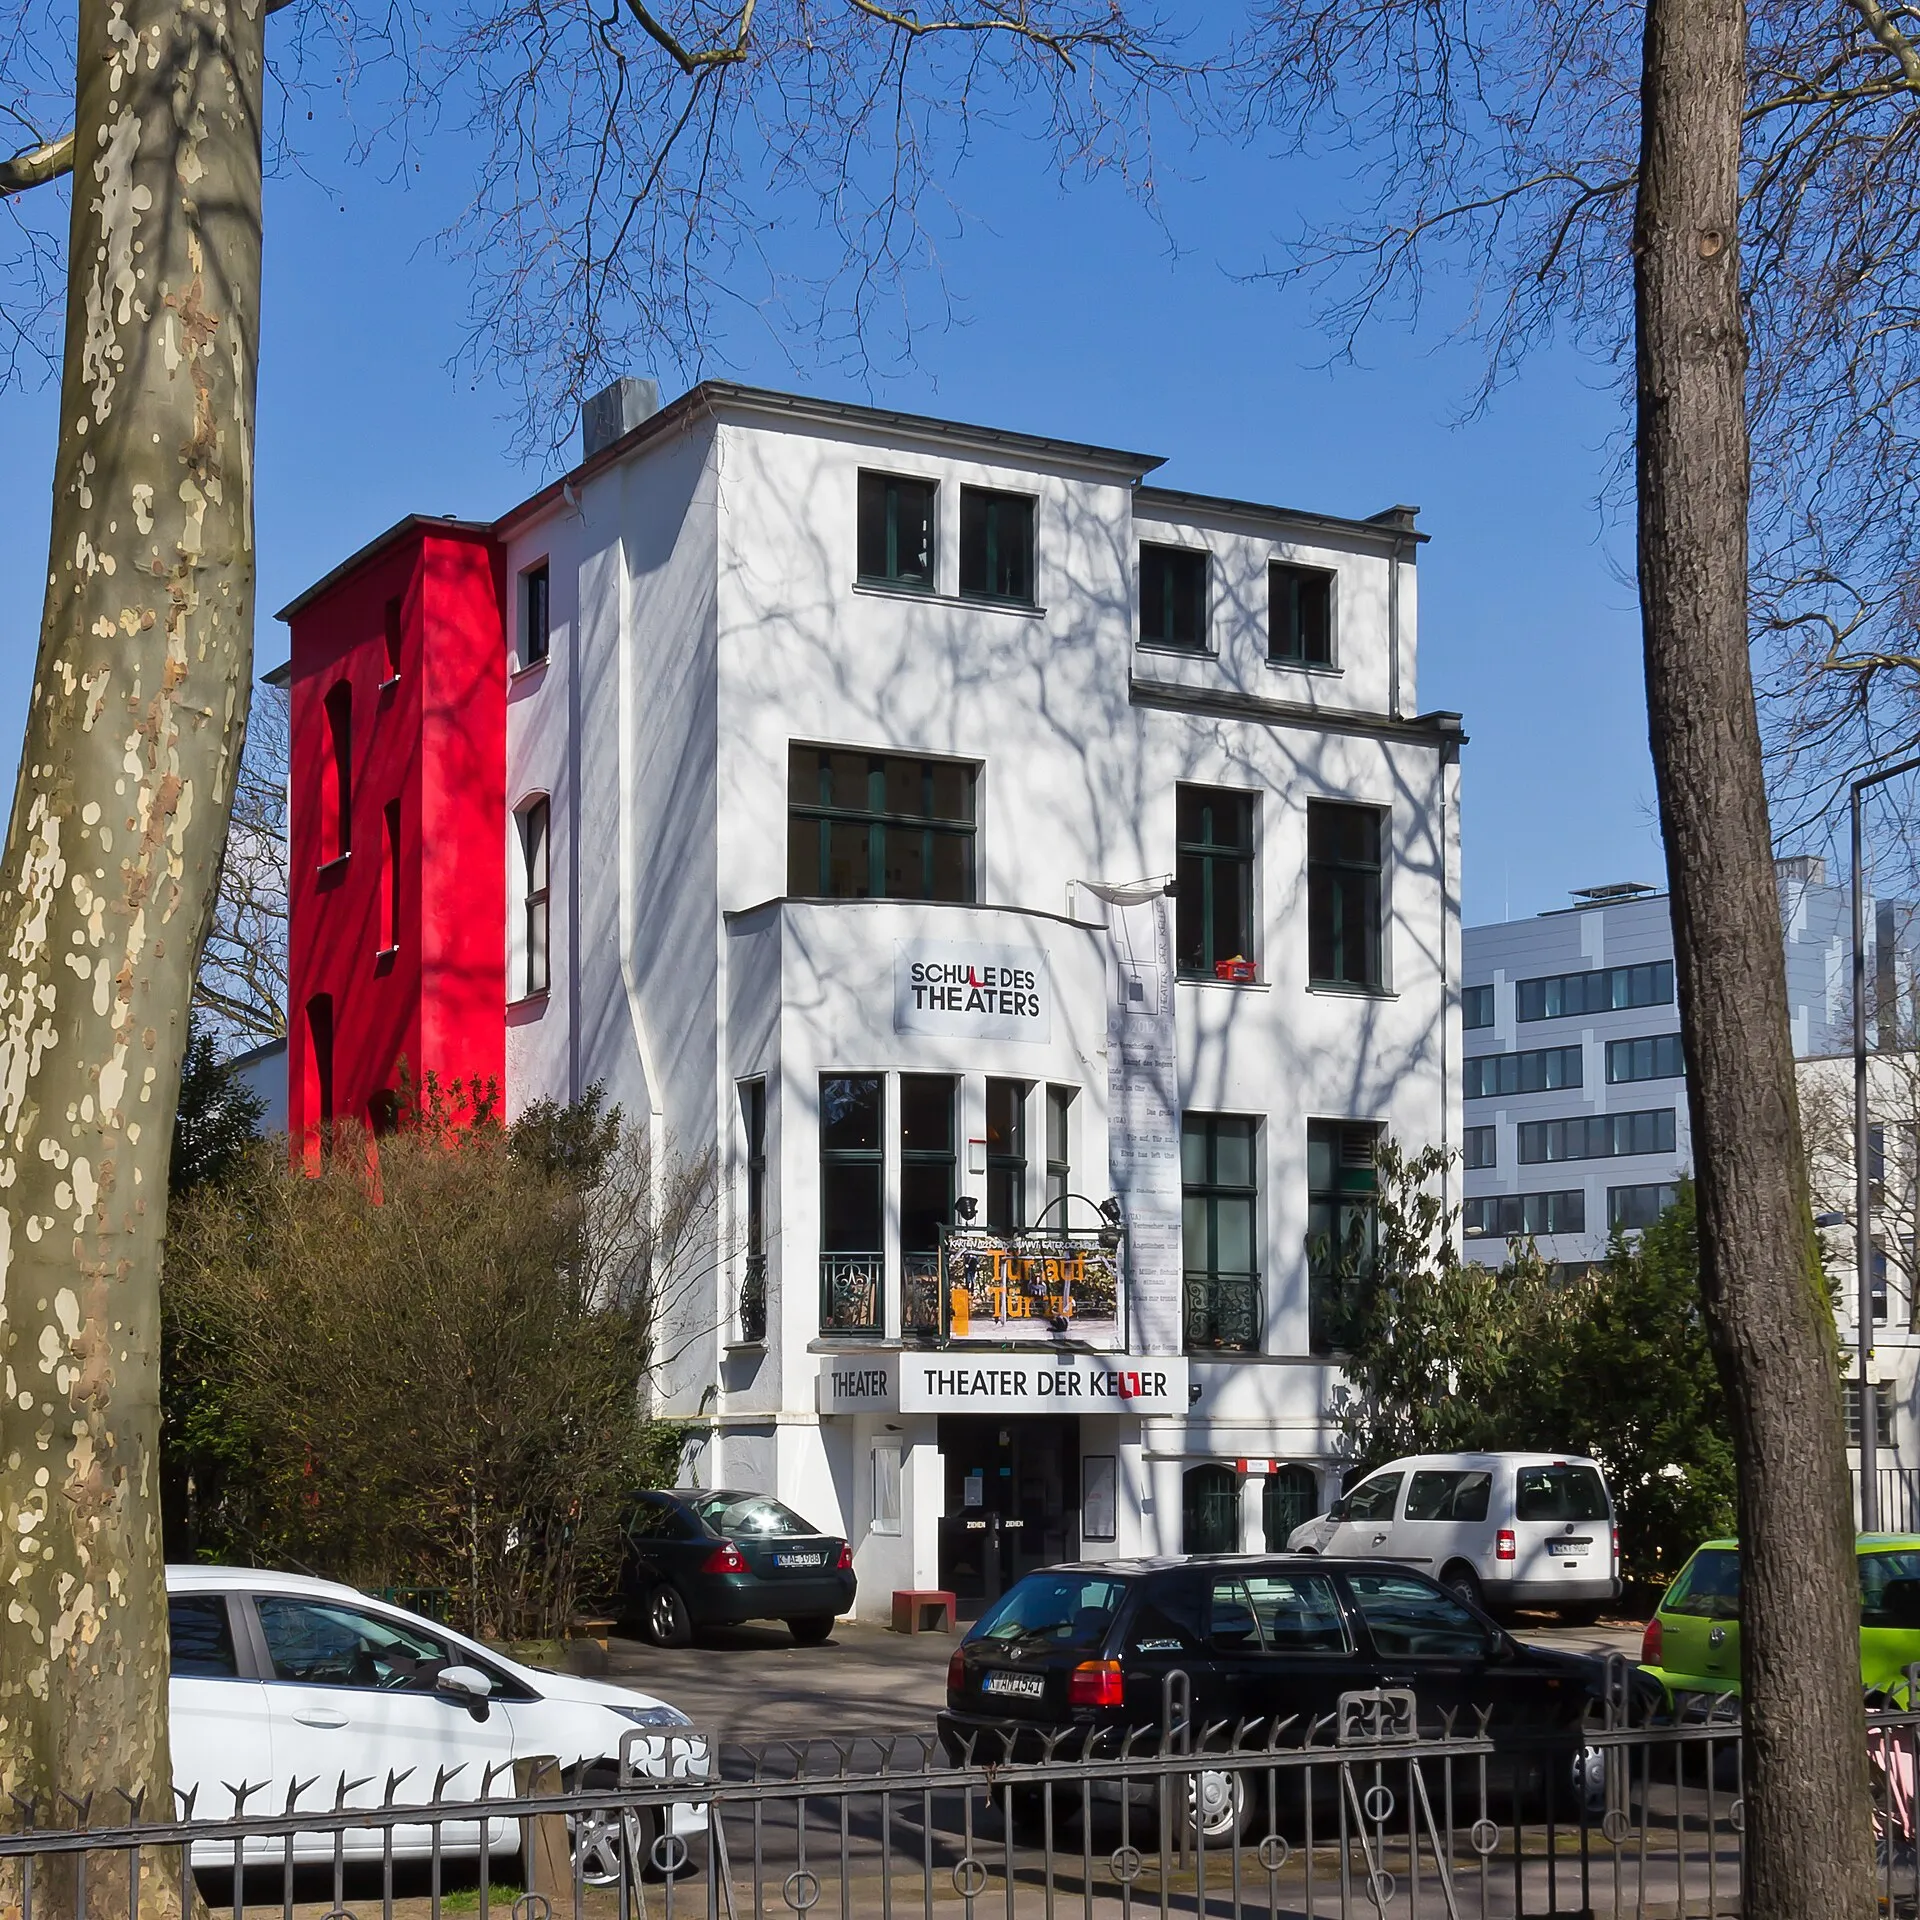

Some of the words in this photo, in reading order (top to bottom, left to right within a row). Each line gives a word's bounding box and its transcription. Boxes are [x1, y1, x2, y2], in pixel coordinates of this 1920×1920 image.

[911, 962, 996, 988] SCHULE
[1000, 967, 1035, 990] DES
[911, 984, 1040, 1017] THEATERS
[986, 1249, 1036, 1282] Tür
[1043, 1250, 1088, 1282] auf
[986, 1286, 1033, 1319] Tür
[831, 1370, 888, 1398] THEATER
[924, 1370, 1028, 1397] THEATER
[1037, 1371, 1083, 1397] DER
[1090, 1372, 1168, 1401] KELLER
